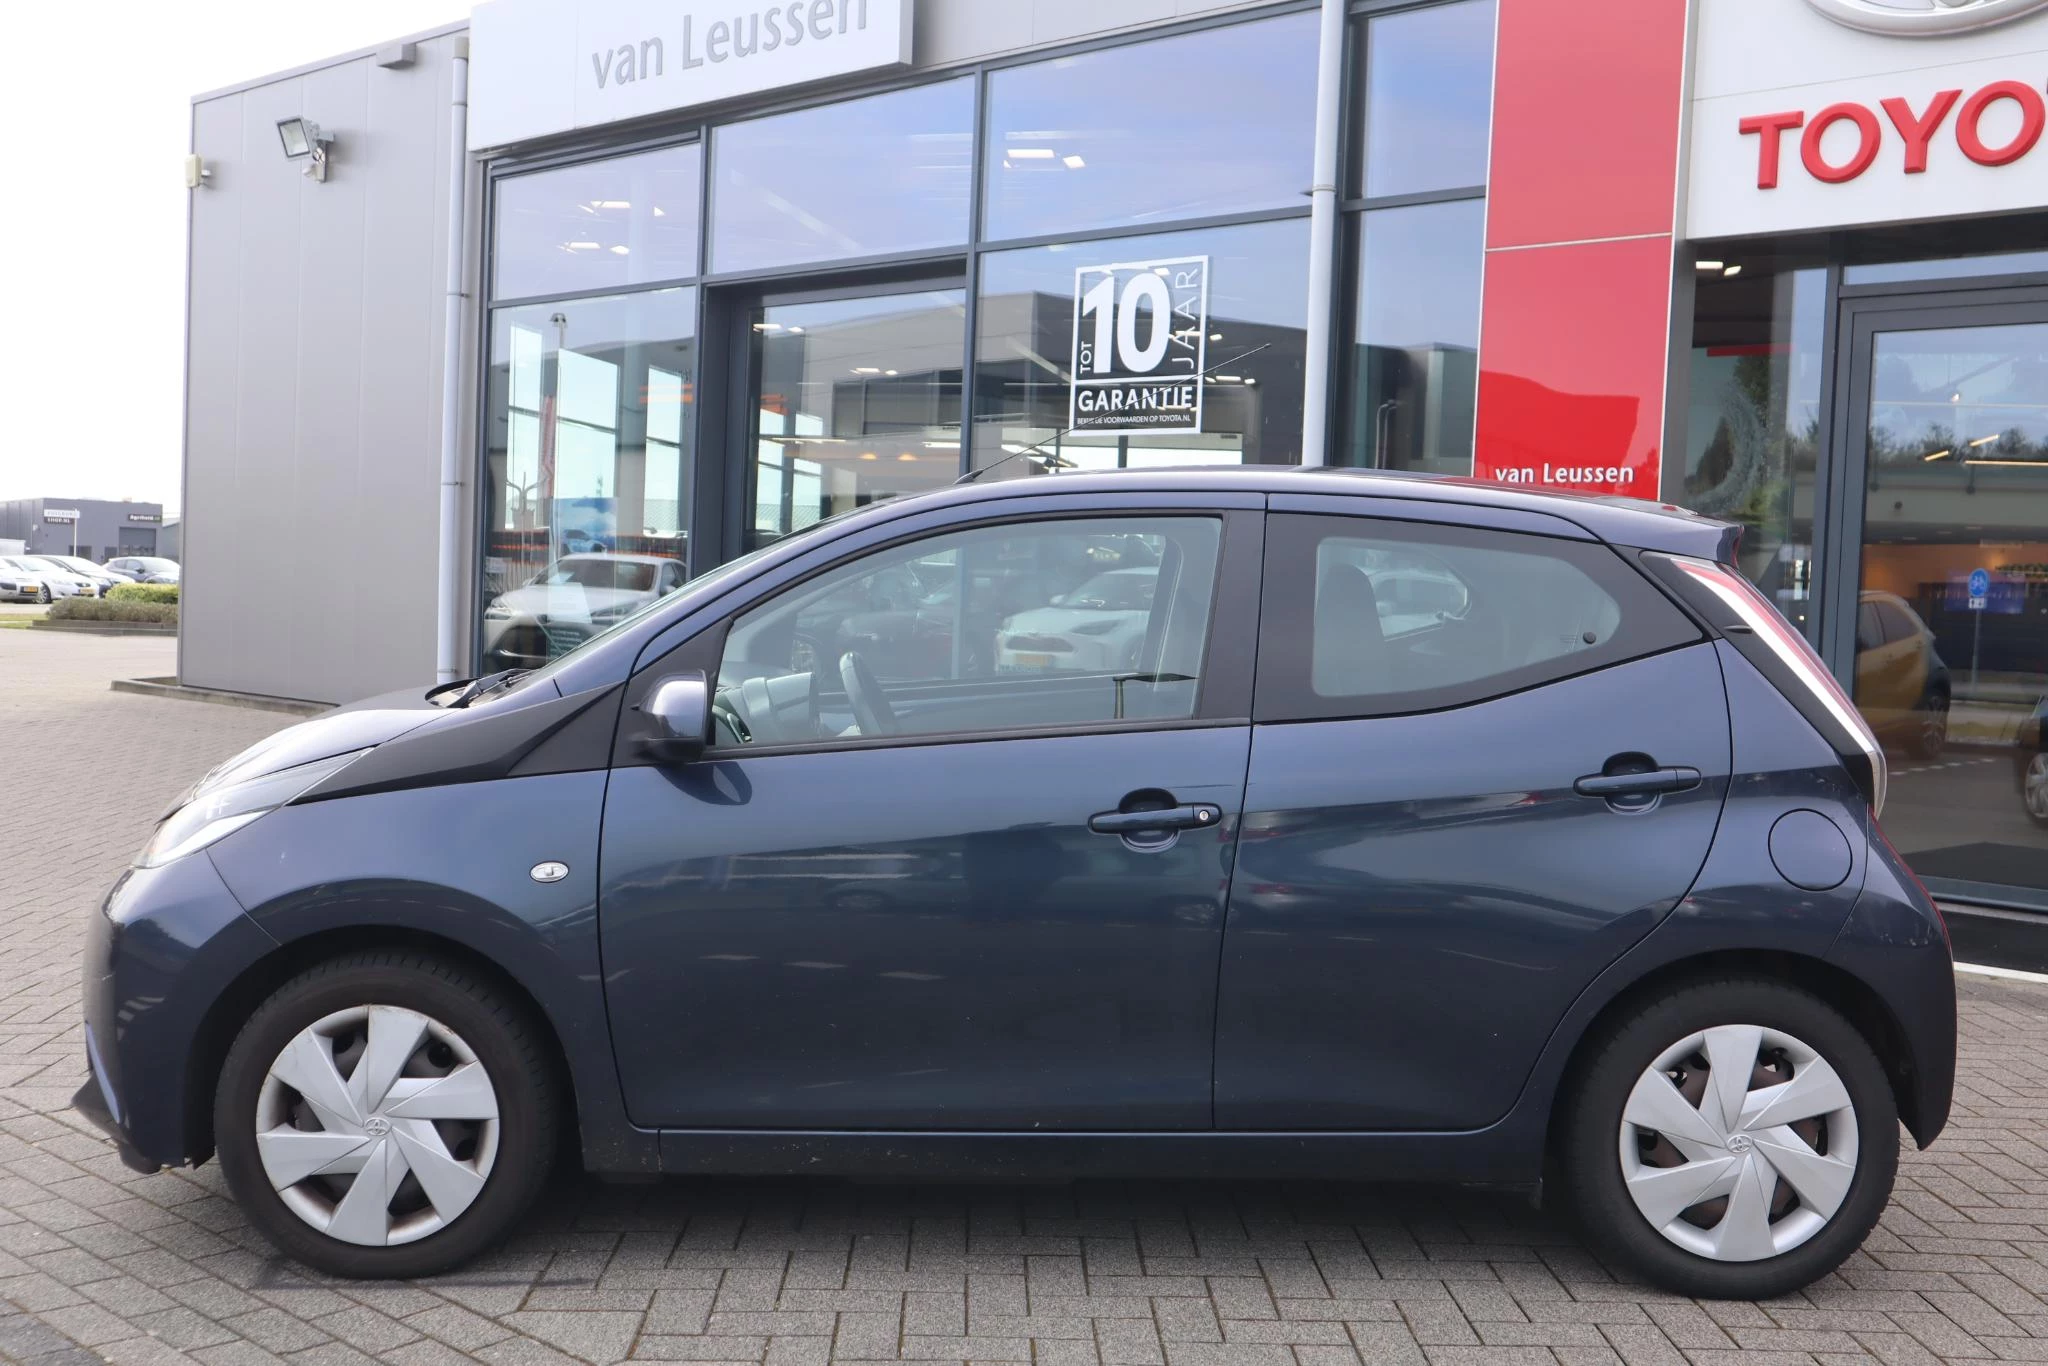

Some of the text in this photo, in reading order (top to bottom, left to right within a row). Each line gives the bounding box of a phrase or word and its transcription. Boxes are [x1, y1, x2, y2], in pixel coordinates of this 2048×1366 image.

[591, 0, 867, 89] van Leussen
[1739, 78, 2048, 189] TOYO
[1082, 272, 1171, 374] 10
[1172, 267, 1198, 369] JAAR
[1080, 341, 1092, 374] TOT
[1078, 386, 1193, 412] GARANTIE
[1103, 415, 1149, 424] VOORWAARDEN
[1149, 415, 1158, 423] OP
[1158, 414, 1191, 422] TOYOTA.NL
[1495, 463, 1634, 483] van Leussen
